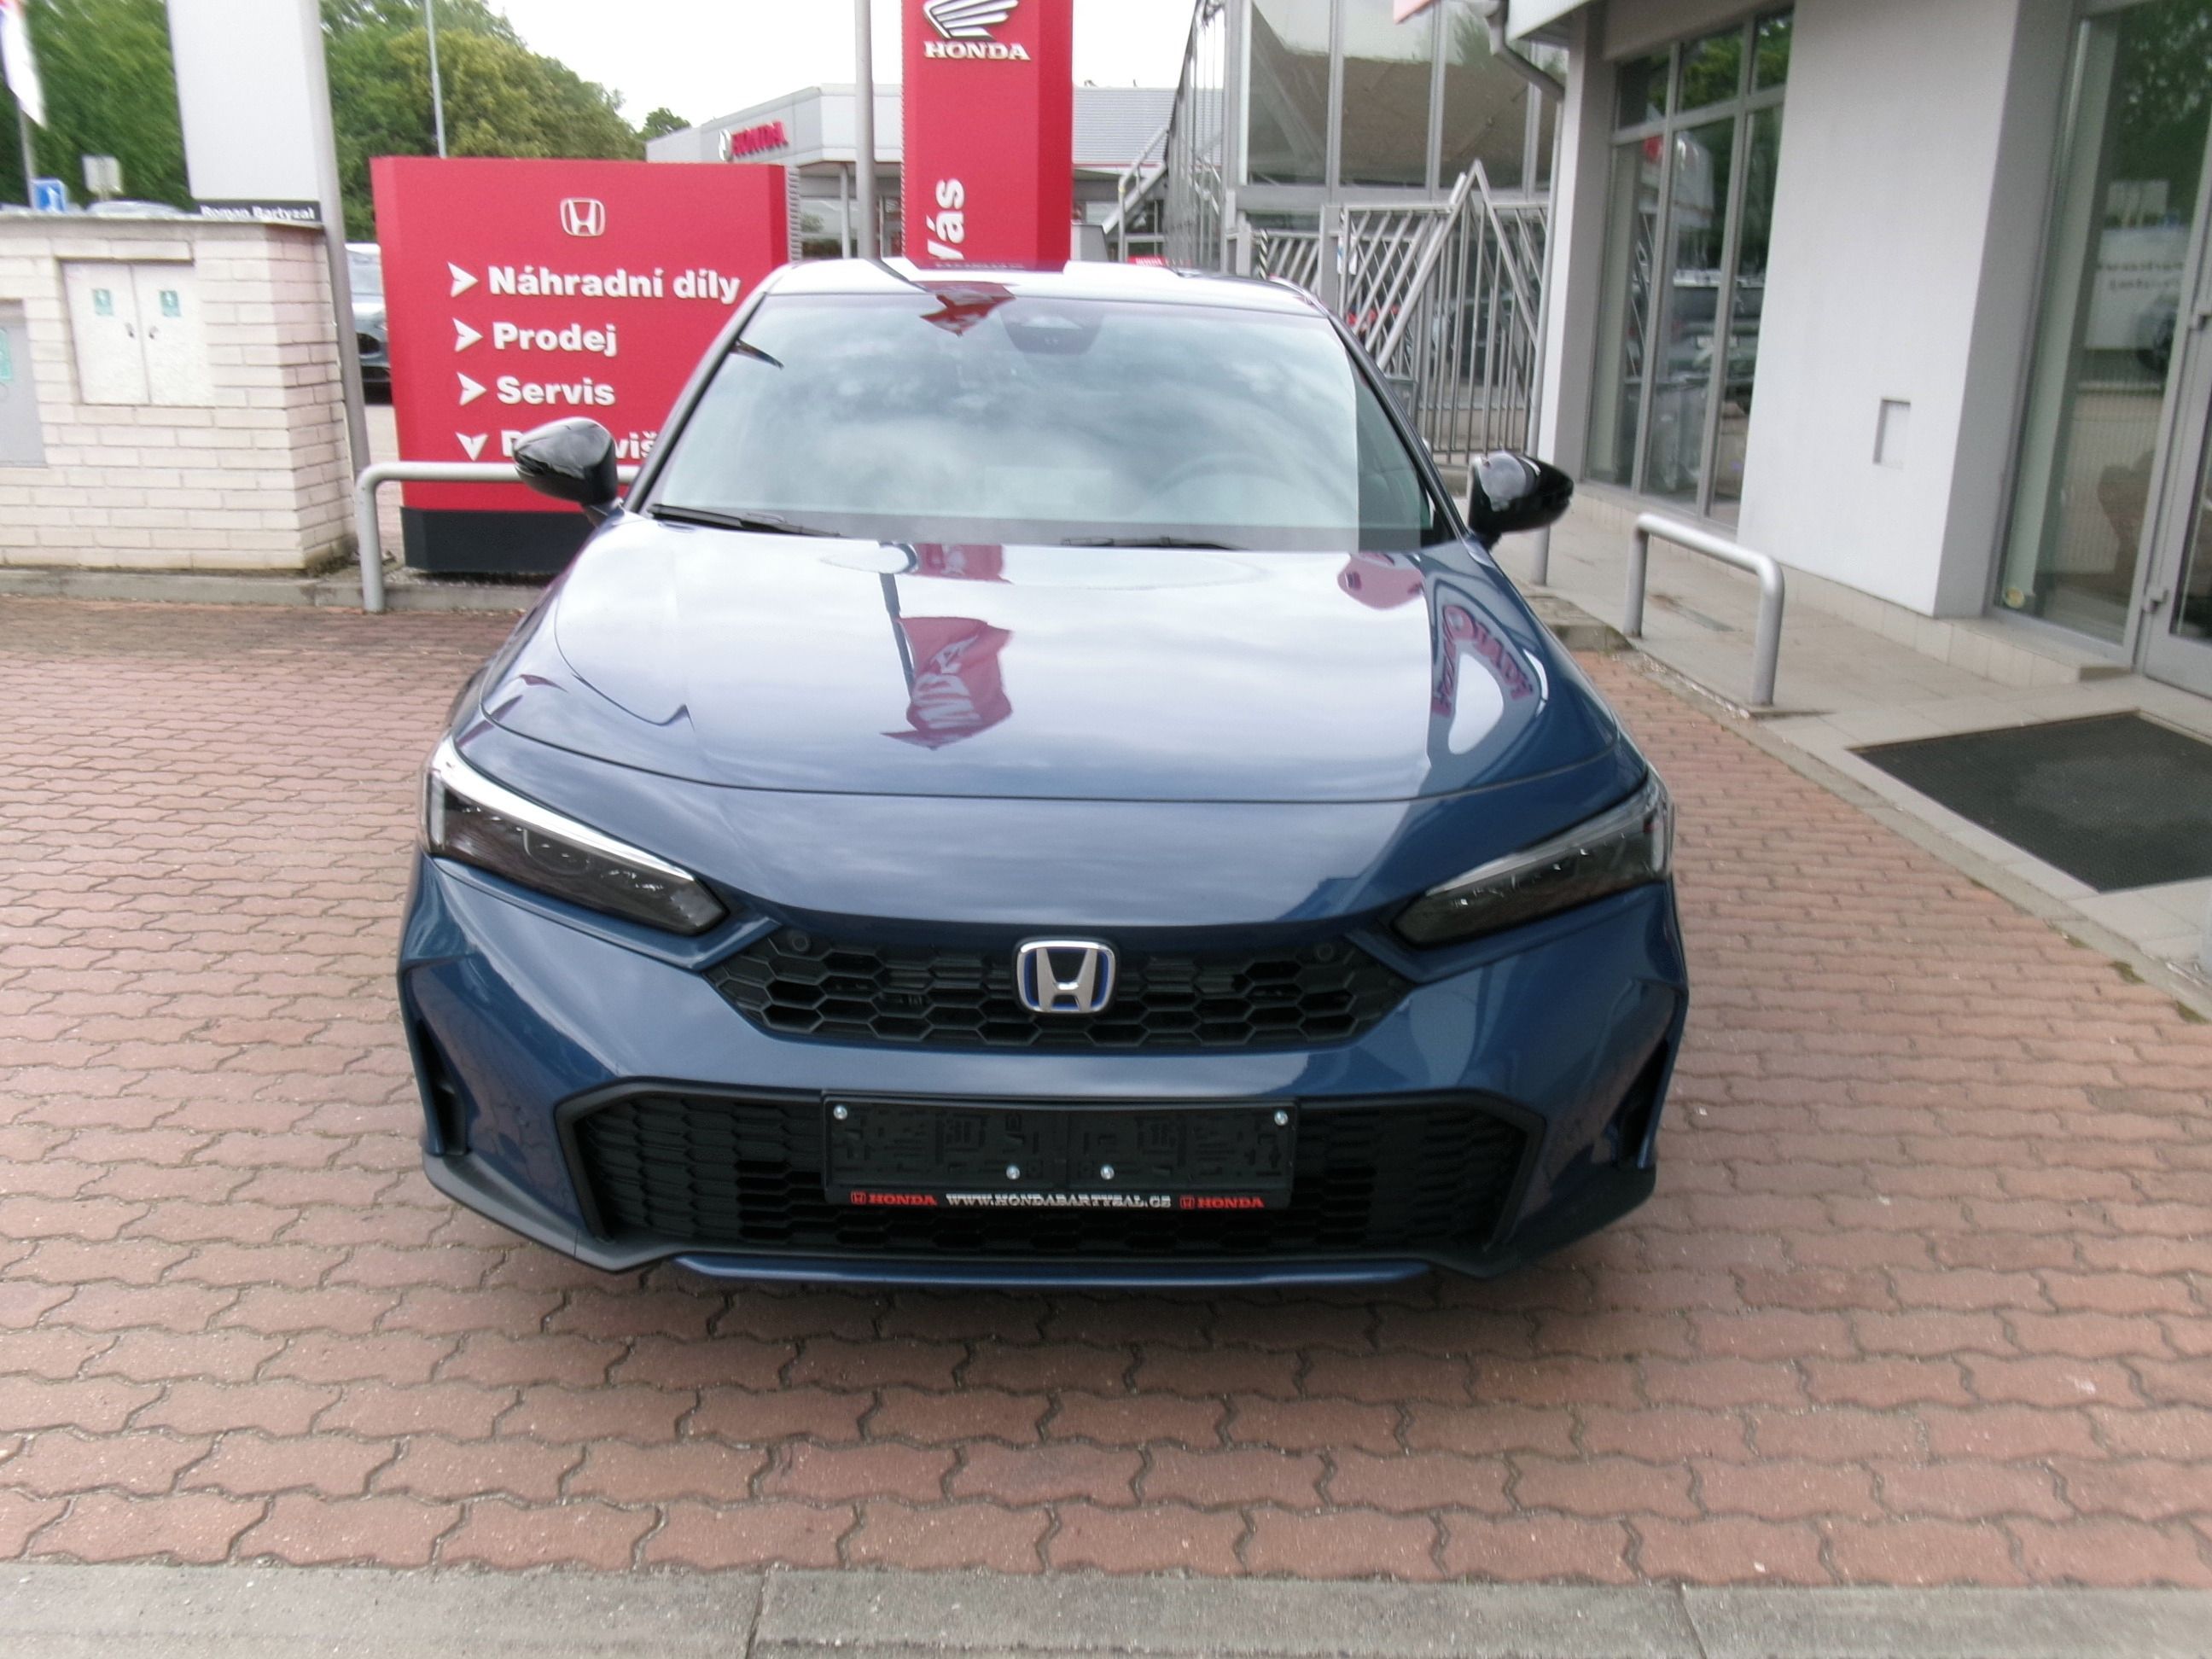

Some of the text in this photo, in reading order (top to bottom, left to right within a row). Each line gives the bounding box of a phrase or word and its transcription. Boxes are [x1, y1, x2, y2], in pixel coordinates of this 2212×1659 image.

[923, 41, 1031, 61] HONDA
[487, 265, 741, 304] Náhradní díly
[492, 321, 617, 357] Prodej
[497, 375, 615, 405] Servis
[869, 1192, 937, 1206] HONDA
[1197, 1196, 1265, 1209] HONDA
